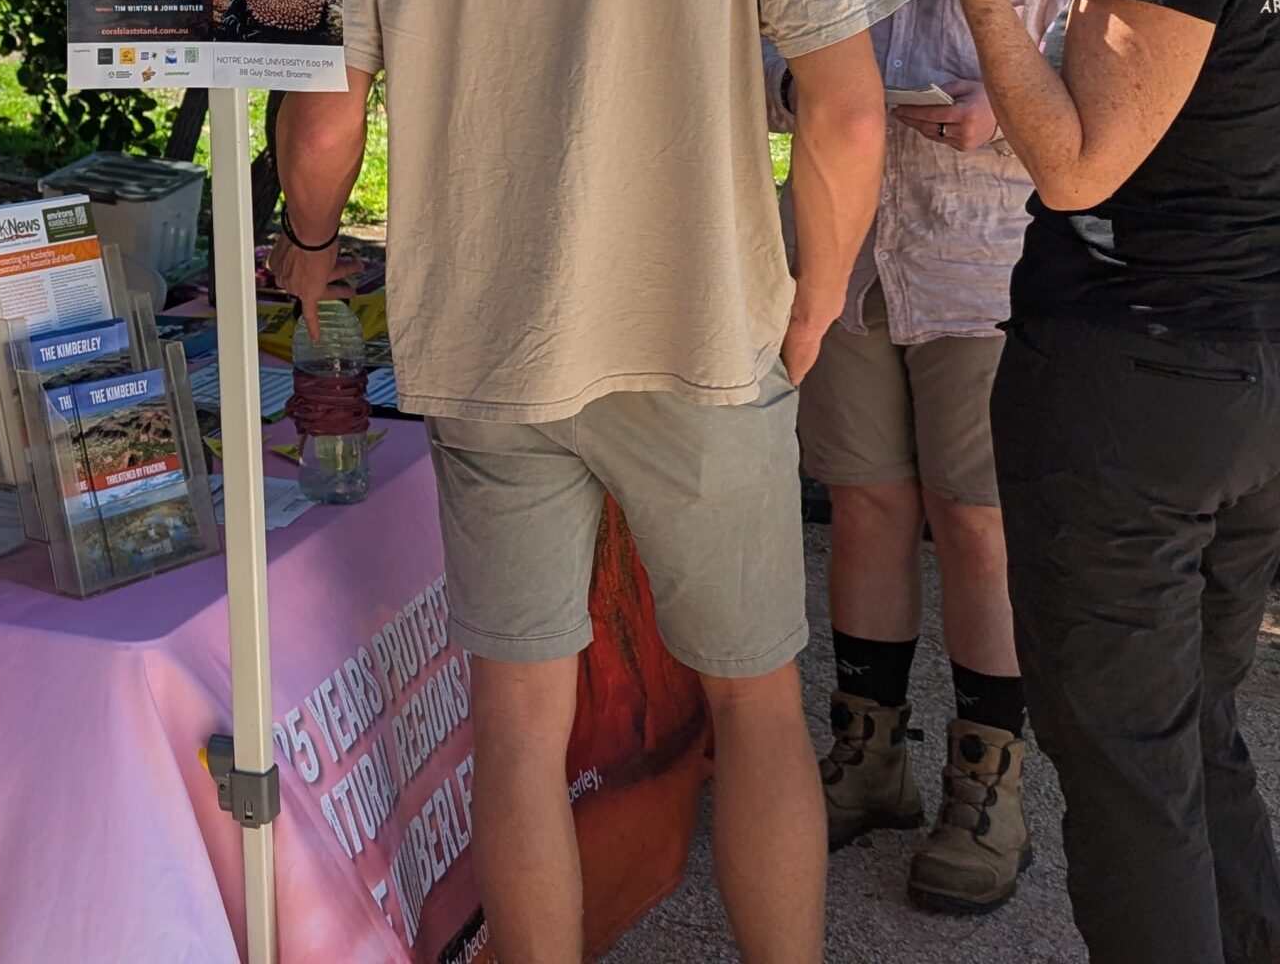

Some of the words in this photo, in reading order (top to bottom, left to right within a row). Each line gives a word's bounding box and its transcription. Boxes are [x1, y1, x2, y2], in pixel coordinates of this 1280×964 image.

[101, 26, 189, 35] coralslaststand.com.au
[216, 56, 242, 64] NOTRE
[243, 57, 264, 65] DAME
[265, 57, 305, 67] UNIVERSITY
[322, 60, 334, 68] PM
[249, 68, 263, 78] Guy
[285, 70, 313, 79] Broome
[46, 209, 74, 221] environs
[40, 345, 56, 362] THE
[56, 336, 101, 358] KIMBERLEY
[89, 388, 107, 405] THE
[106, 379, 148, 400] KIMBERLEY
[304, 644, 384, 763] YEARS
[391, 655, 469, 786] REGIONS
